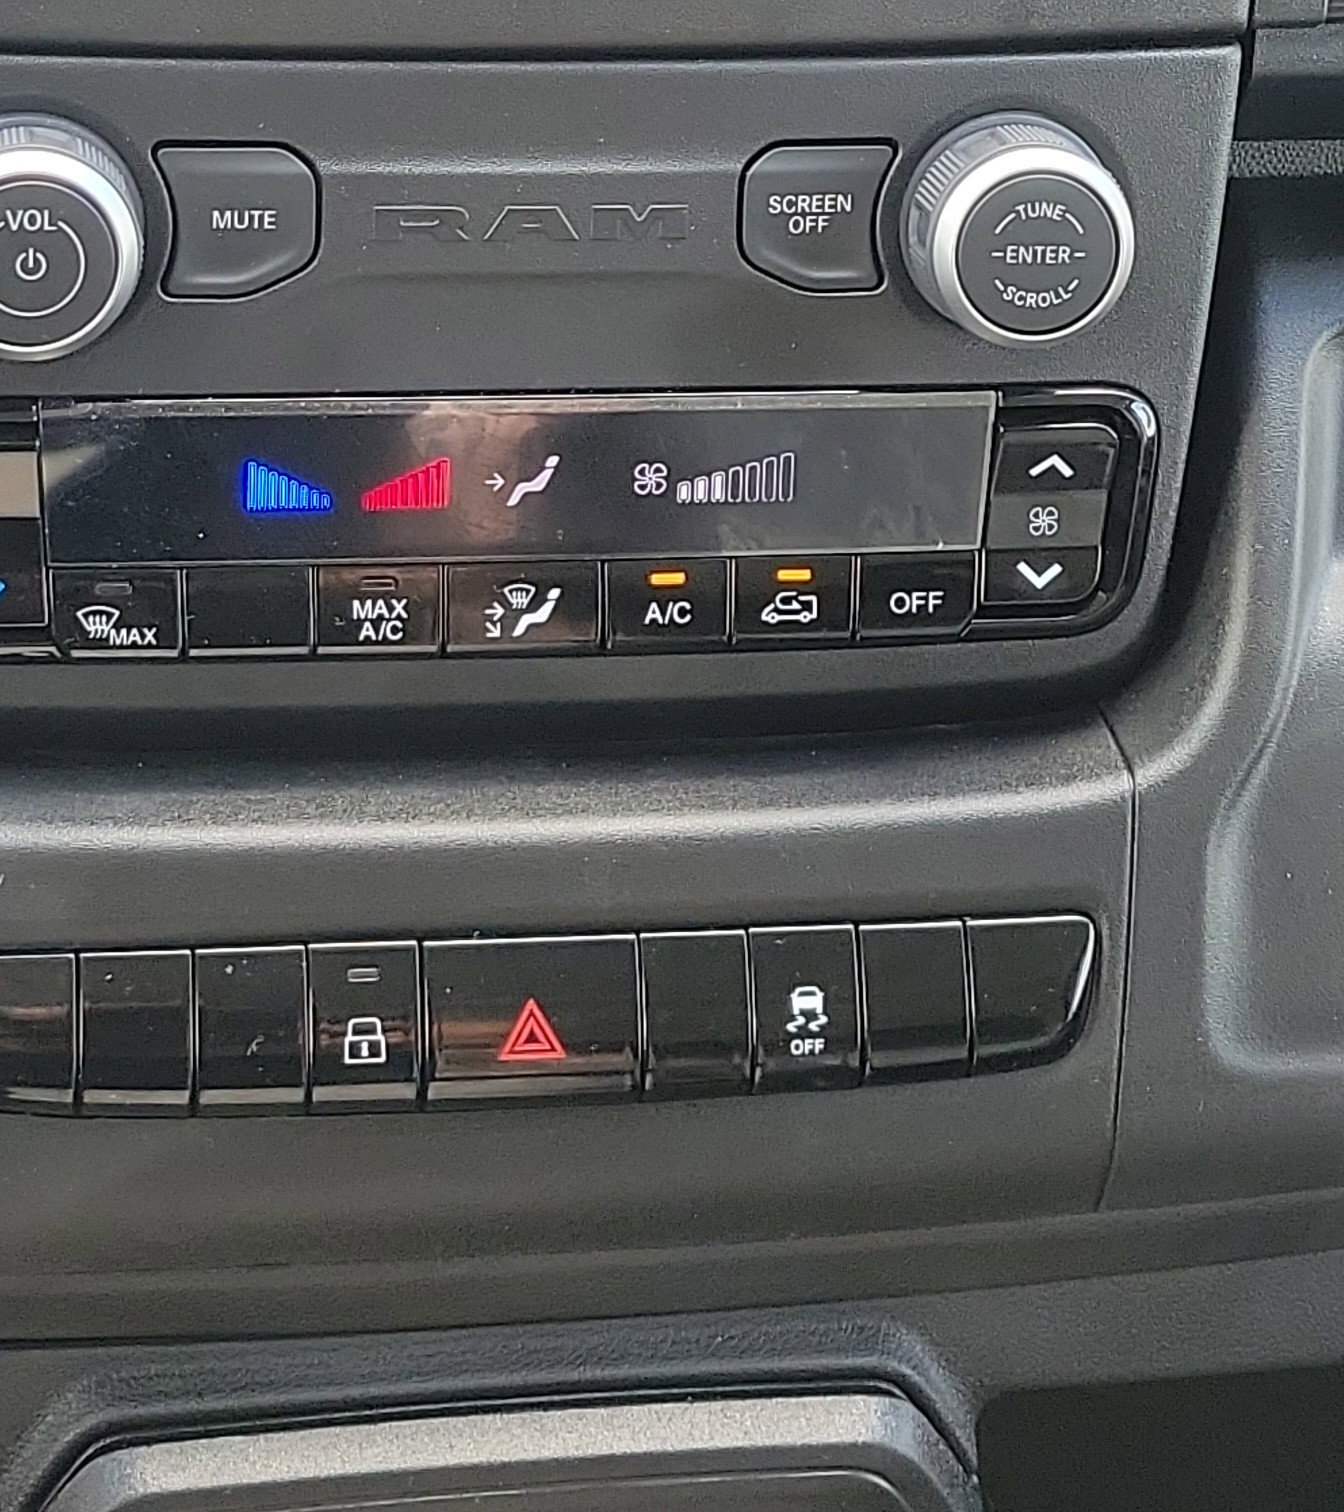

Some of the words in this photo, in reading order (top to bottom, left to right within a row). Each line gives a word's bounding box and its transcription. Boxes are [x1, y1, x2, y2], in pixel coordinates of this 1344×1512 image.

[767, 192, 854, 216] SCREEN
[1014, 201, 1066, 223] TUNE
[5, 208, 58, 232] VOL
[210, 209, 278, 232] MUTE
[372, 202, 690, 242] RAM
[787, 215, 830, 236] OFF
[1004, 243, 1073, 266] ENTER
[1001, 283, 1073, 310] SCROLL
[350, 598, 409, 620] MAX
[644, 600, 693, 627] A/C
[889, 591, 944, 615] OFF
[108, 624, 158, 647] MAX
[357, 619, 405, 642] A/C
[790, 1037, 825, 1056] OFF
